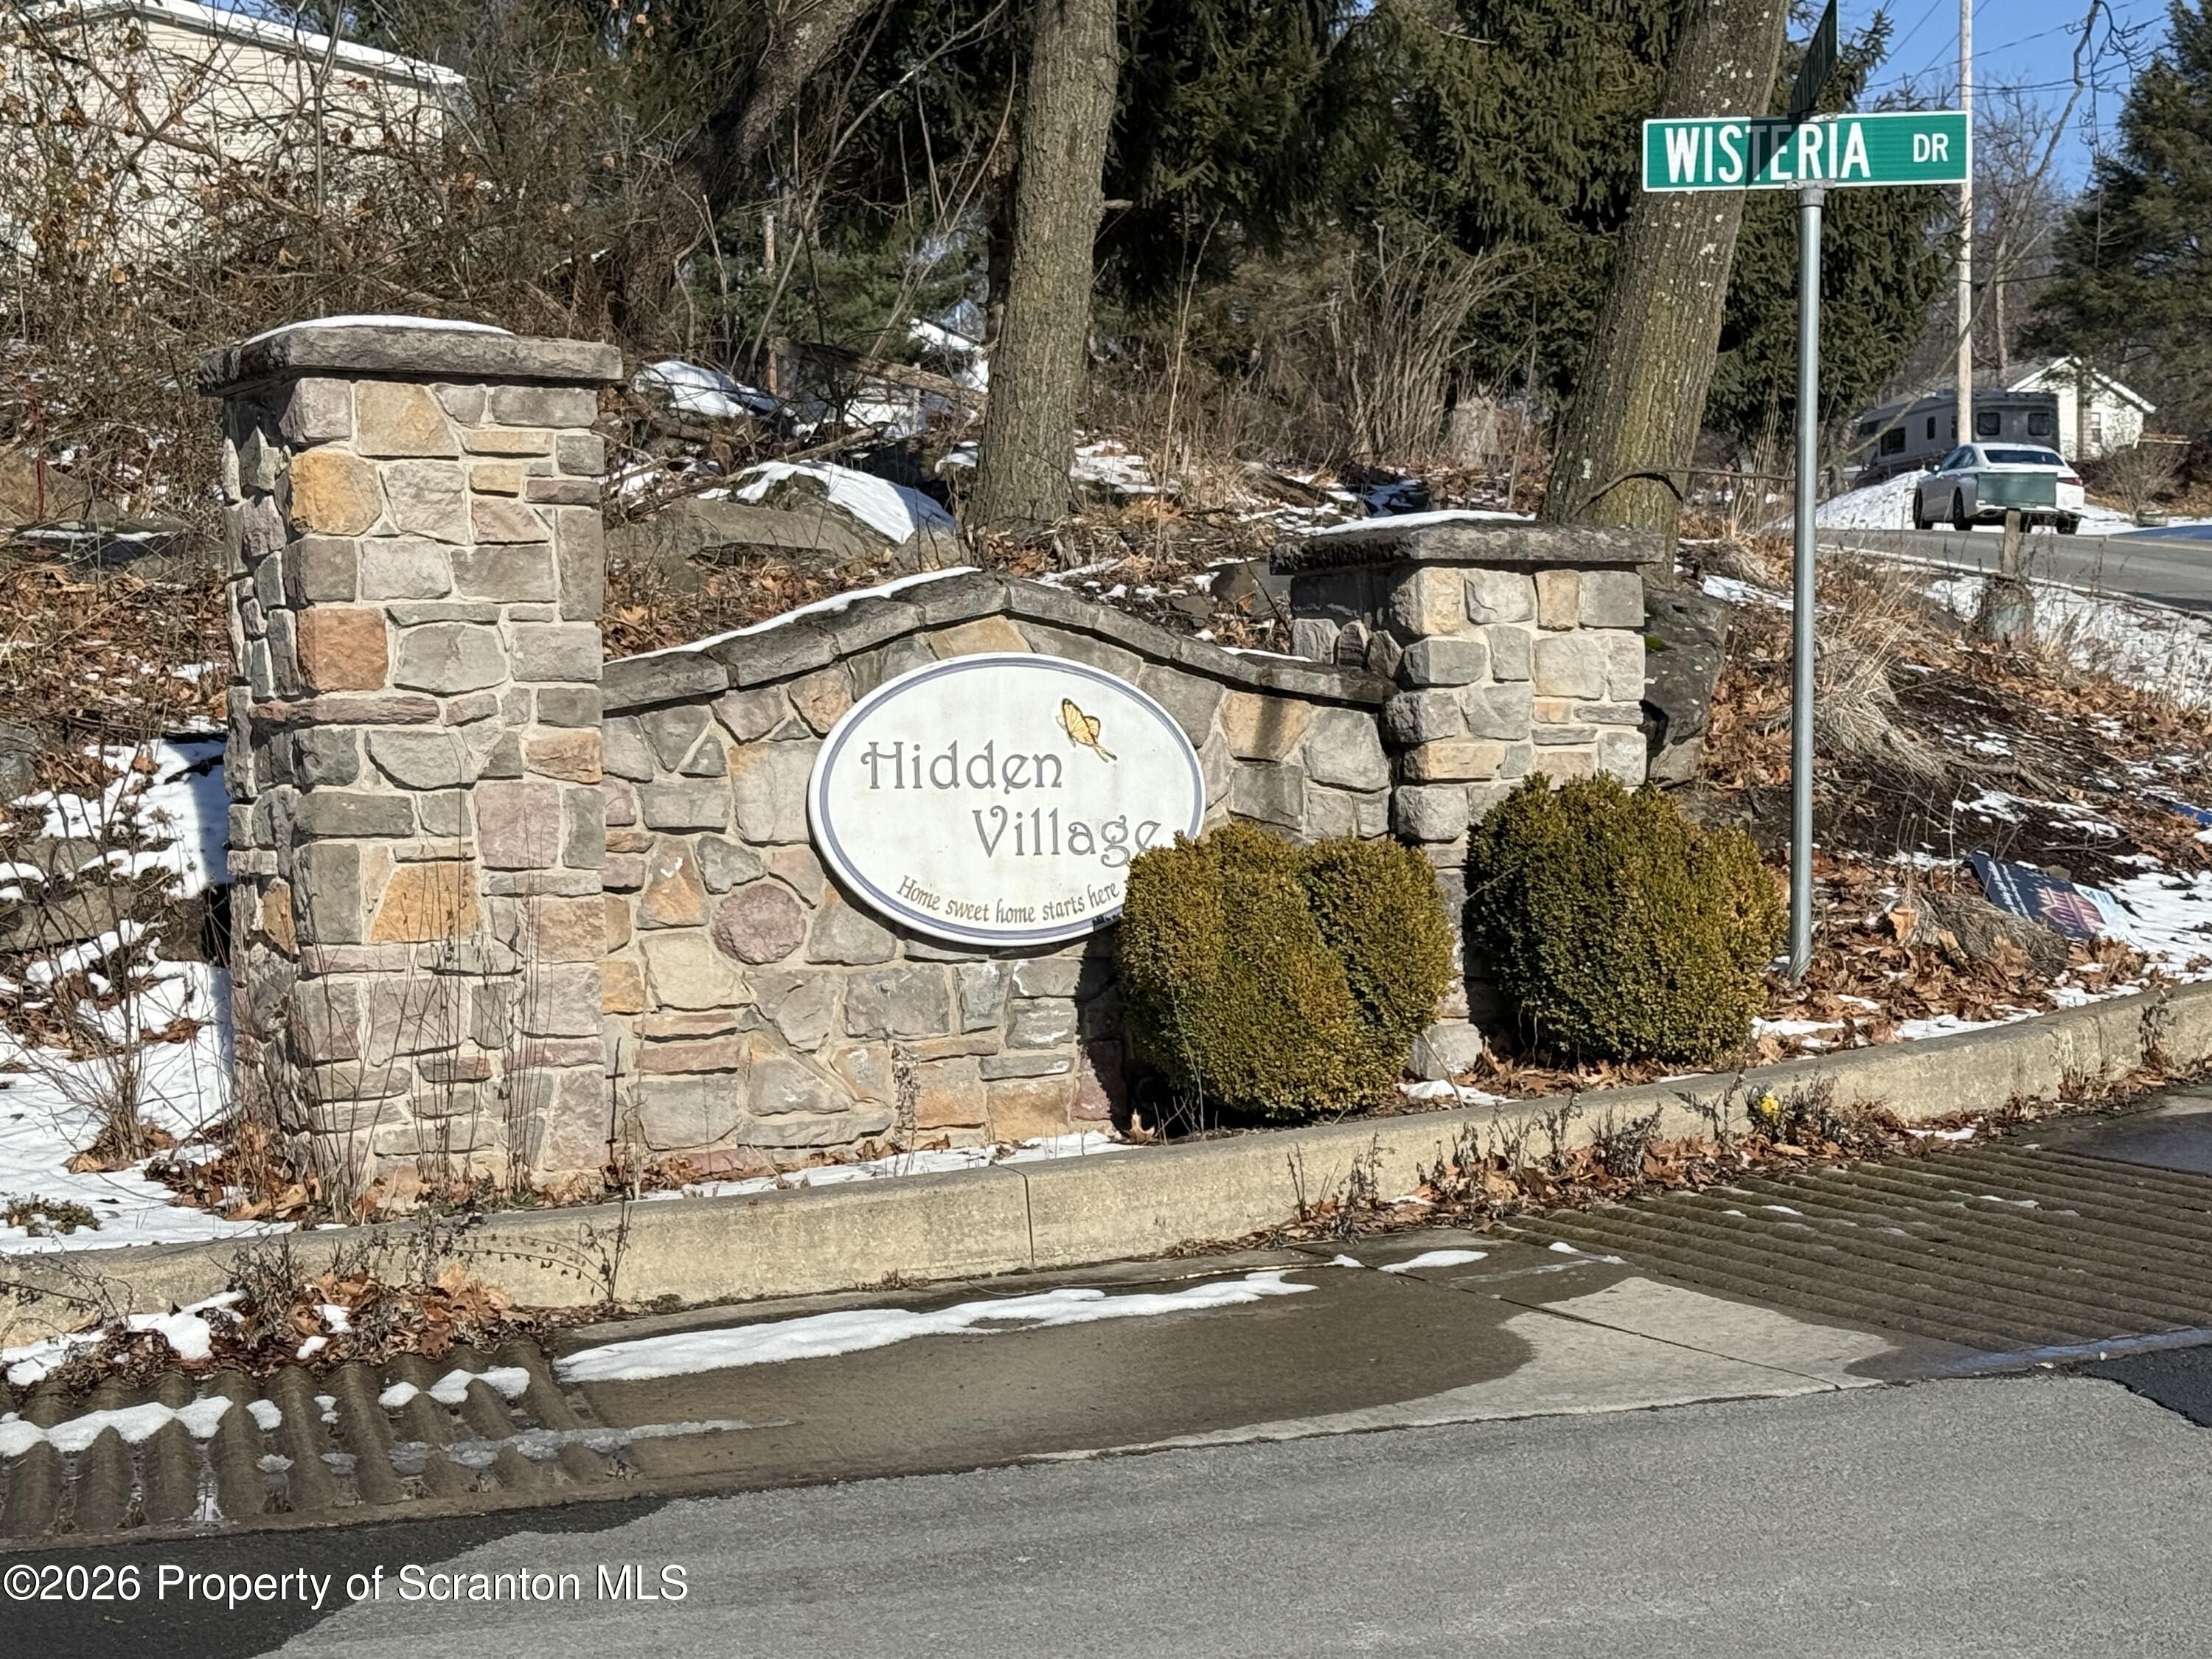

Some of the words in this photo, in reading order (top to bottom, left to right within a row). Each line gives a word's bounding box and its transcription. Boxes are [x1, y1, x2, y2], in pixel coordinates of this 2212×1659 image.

[1664, 122, 1871, 184] WISTERIA
[1913, 133, 1949, 163] DR
[860, 740, 1063, 795] Hidden
[972, 805, 1161, 869] Village
[896, 874, 941, 911] Home
[945, 899, 990, 922] sweet
[995, 897, 1037, 923] home
[1042, 897, 1085, 921] starts
[1087, 883, 1120, 909] here
